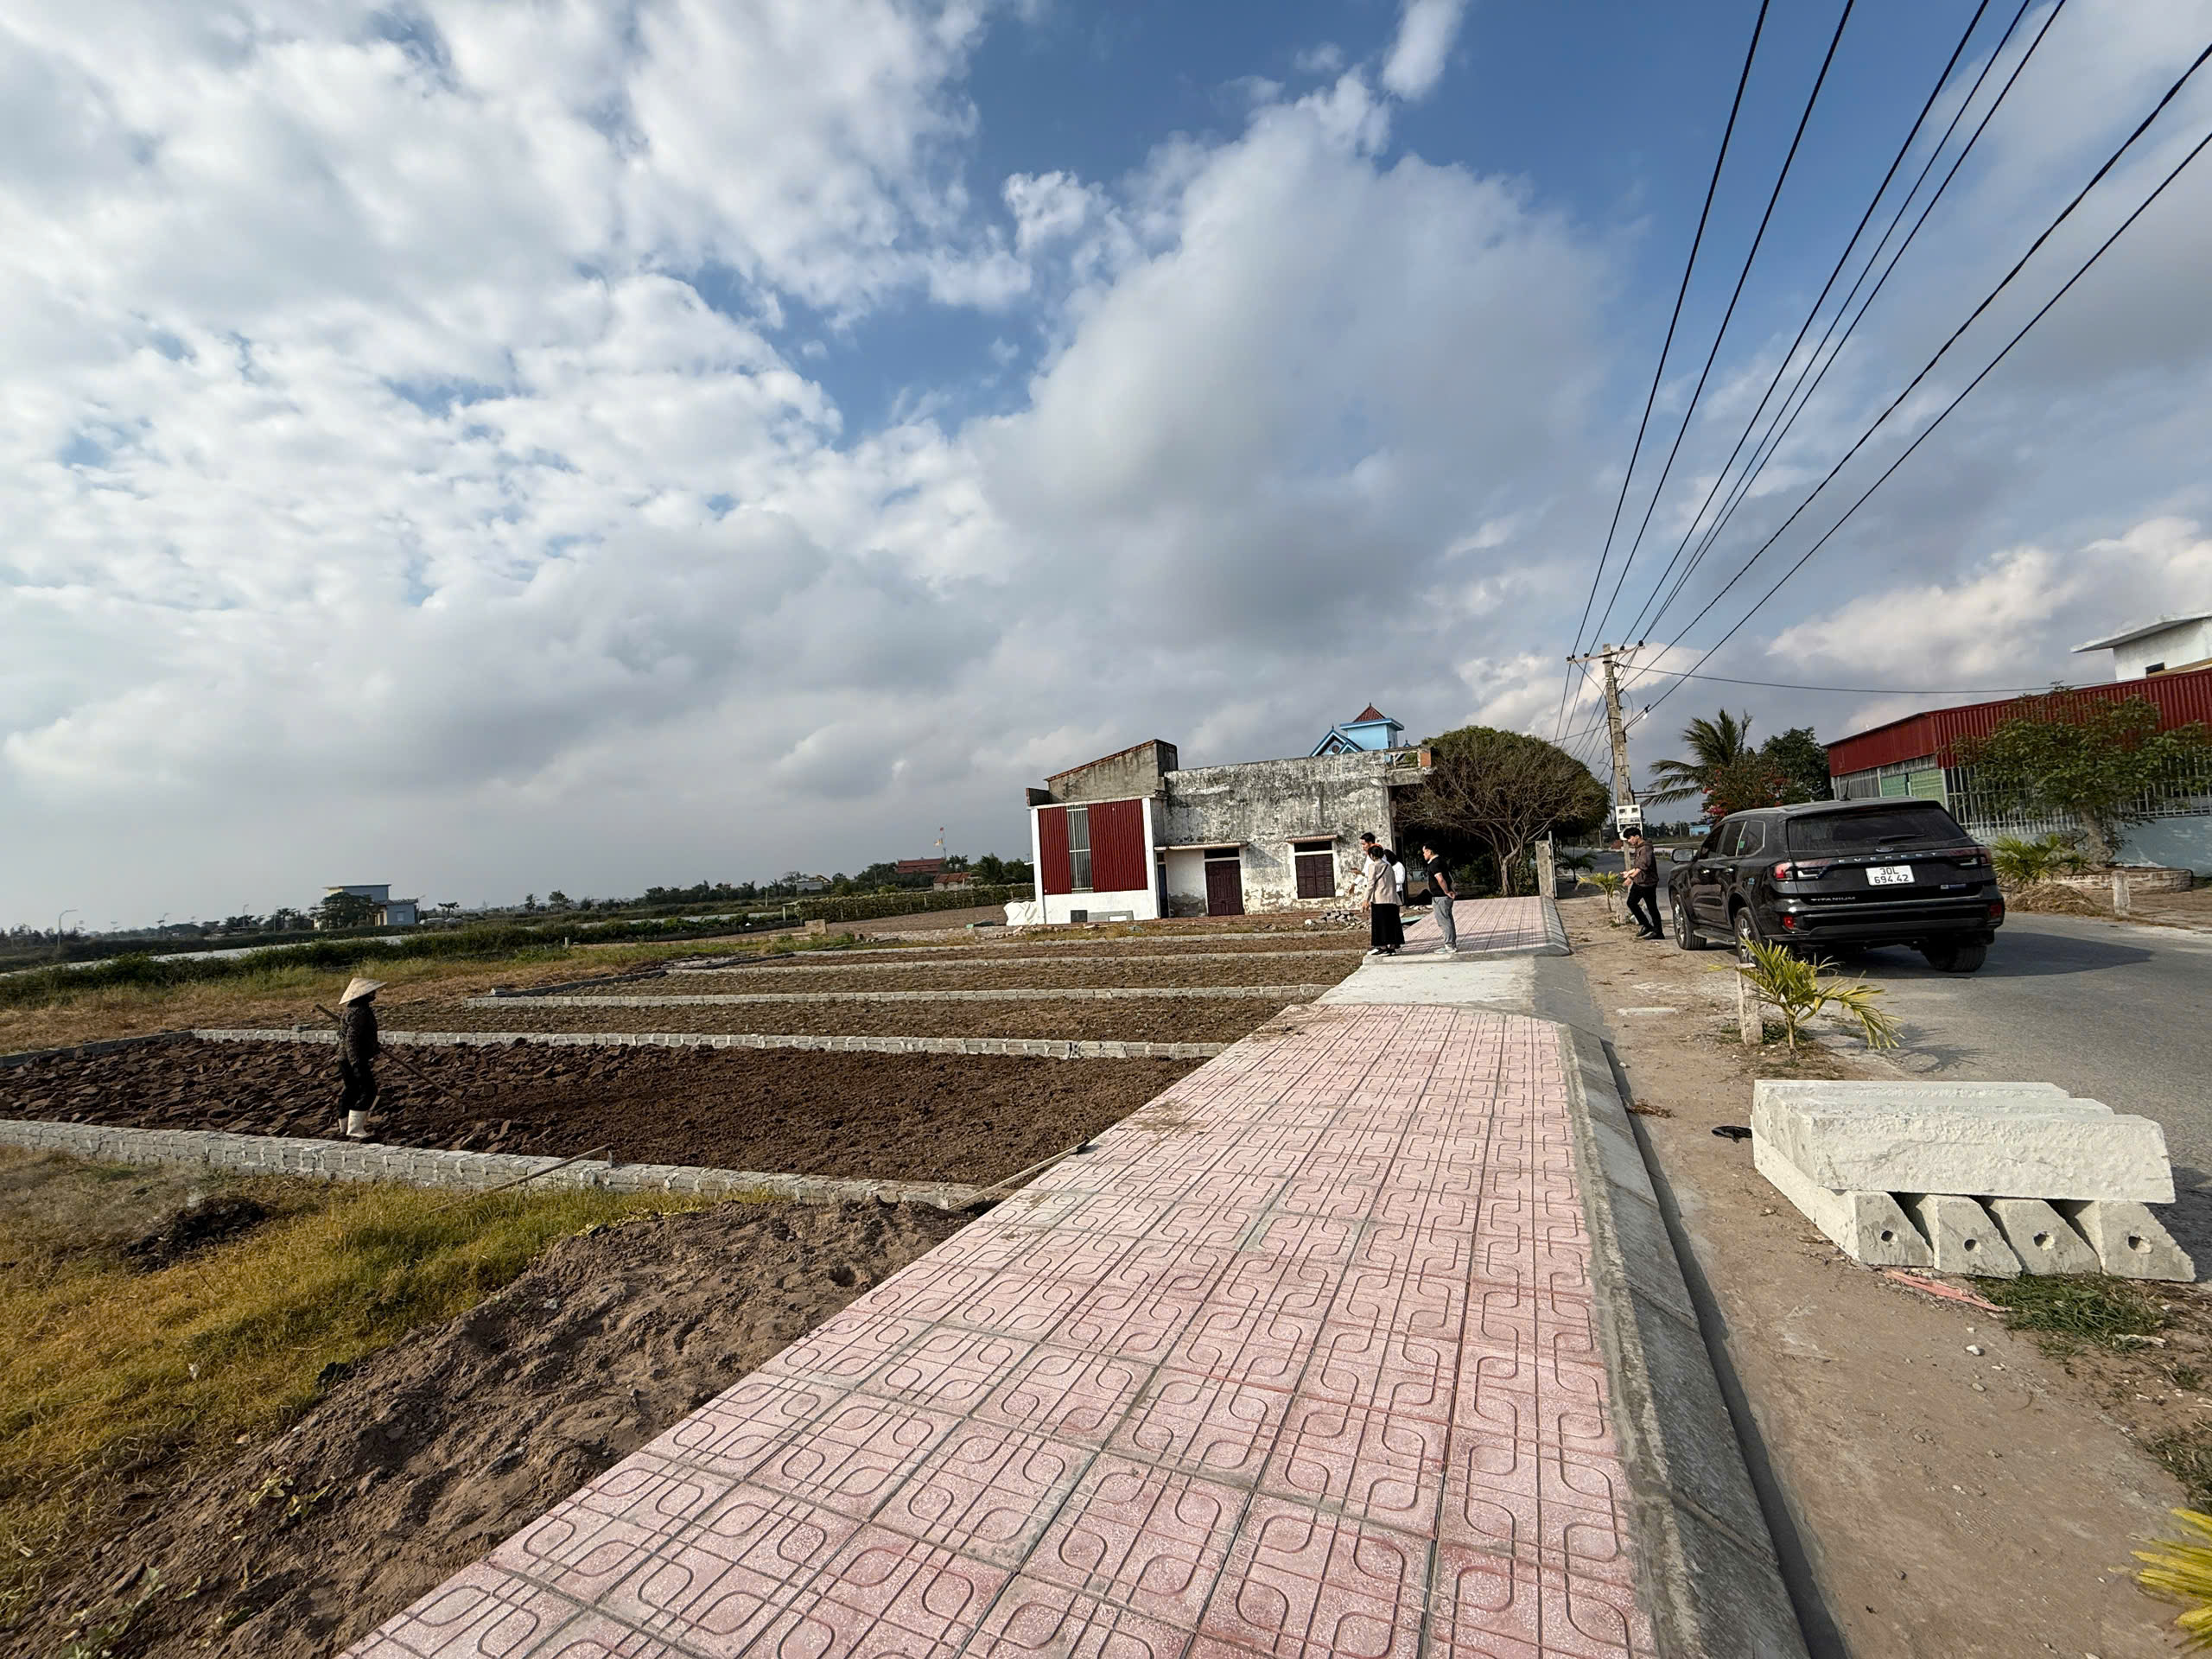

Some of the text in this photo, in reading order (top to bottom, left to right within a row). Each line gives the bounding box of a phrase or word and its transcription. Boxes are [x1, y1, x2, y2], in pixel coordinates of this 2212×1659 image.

[1838, 852, 1936, 863] EVEREST
[1879, 867, 1899, 875] 30L
[1874, 874, 1909, 884] 694.42
